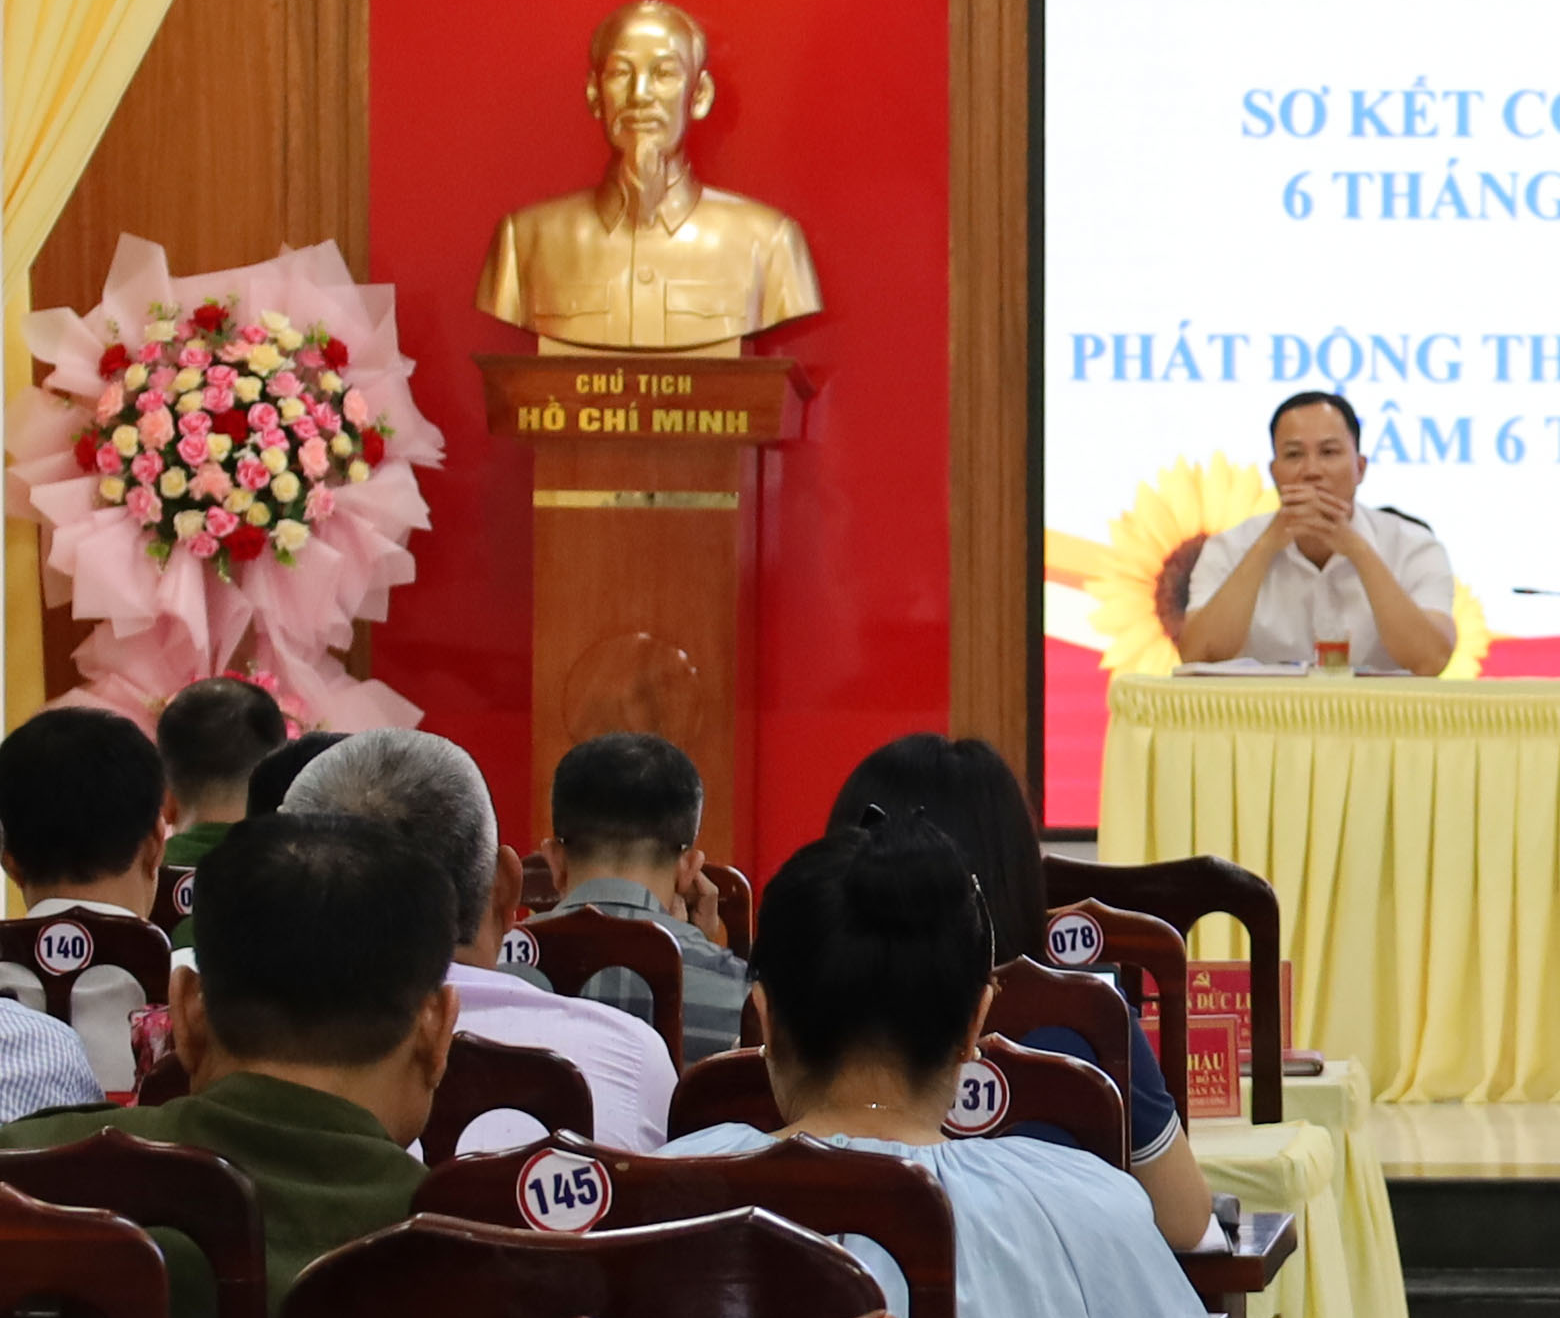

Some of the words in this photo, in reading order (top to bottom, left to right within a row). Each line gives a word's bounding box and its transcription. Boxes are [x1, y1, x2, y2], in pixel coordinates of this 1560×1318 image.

[1242, 85, 1330, 137] SƠ
[1350, 76, 1484, 137] KẾT
[1071, 319, 1249, 383] PHÁT
[1269, 326, 1463, 400] ĐỘNG
[576, 368, 624, 394] CHỦ
[638, 374, 692, 398] TỊCH
[519, 395, 565, 431] HỒ
[579, 401, 638, 432] CHÍ
[652, 408, 749, 433] MINH
[1360, 401, 1475, 465] ÂM
[1495, 415, 1527, 465] 6
[43, 936, 84, 959] 140
[504, 941, 530, 962] 13
[1052, 925, 1095, 954] 078
[954, 1078, 996, 1110] 31
[528, 1166, 597, 1215] 145
